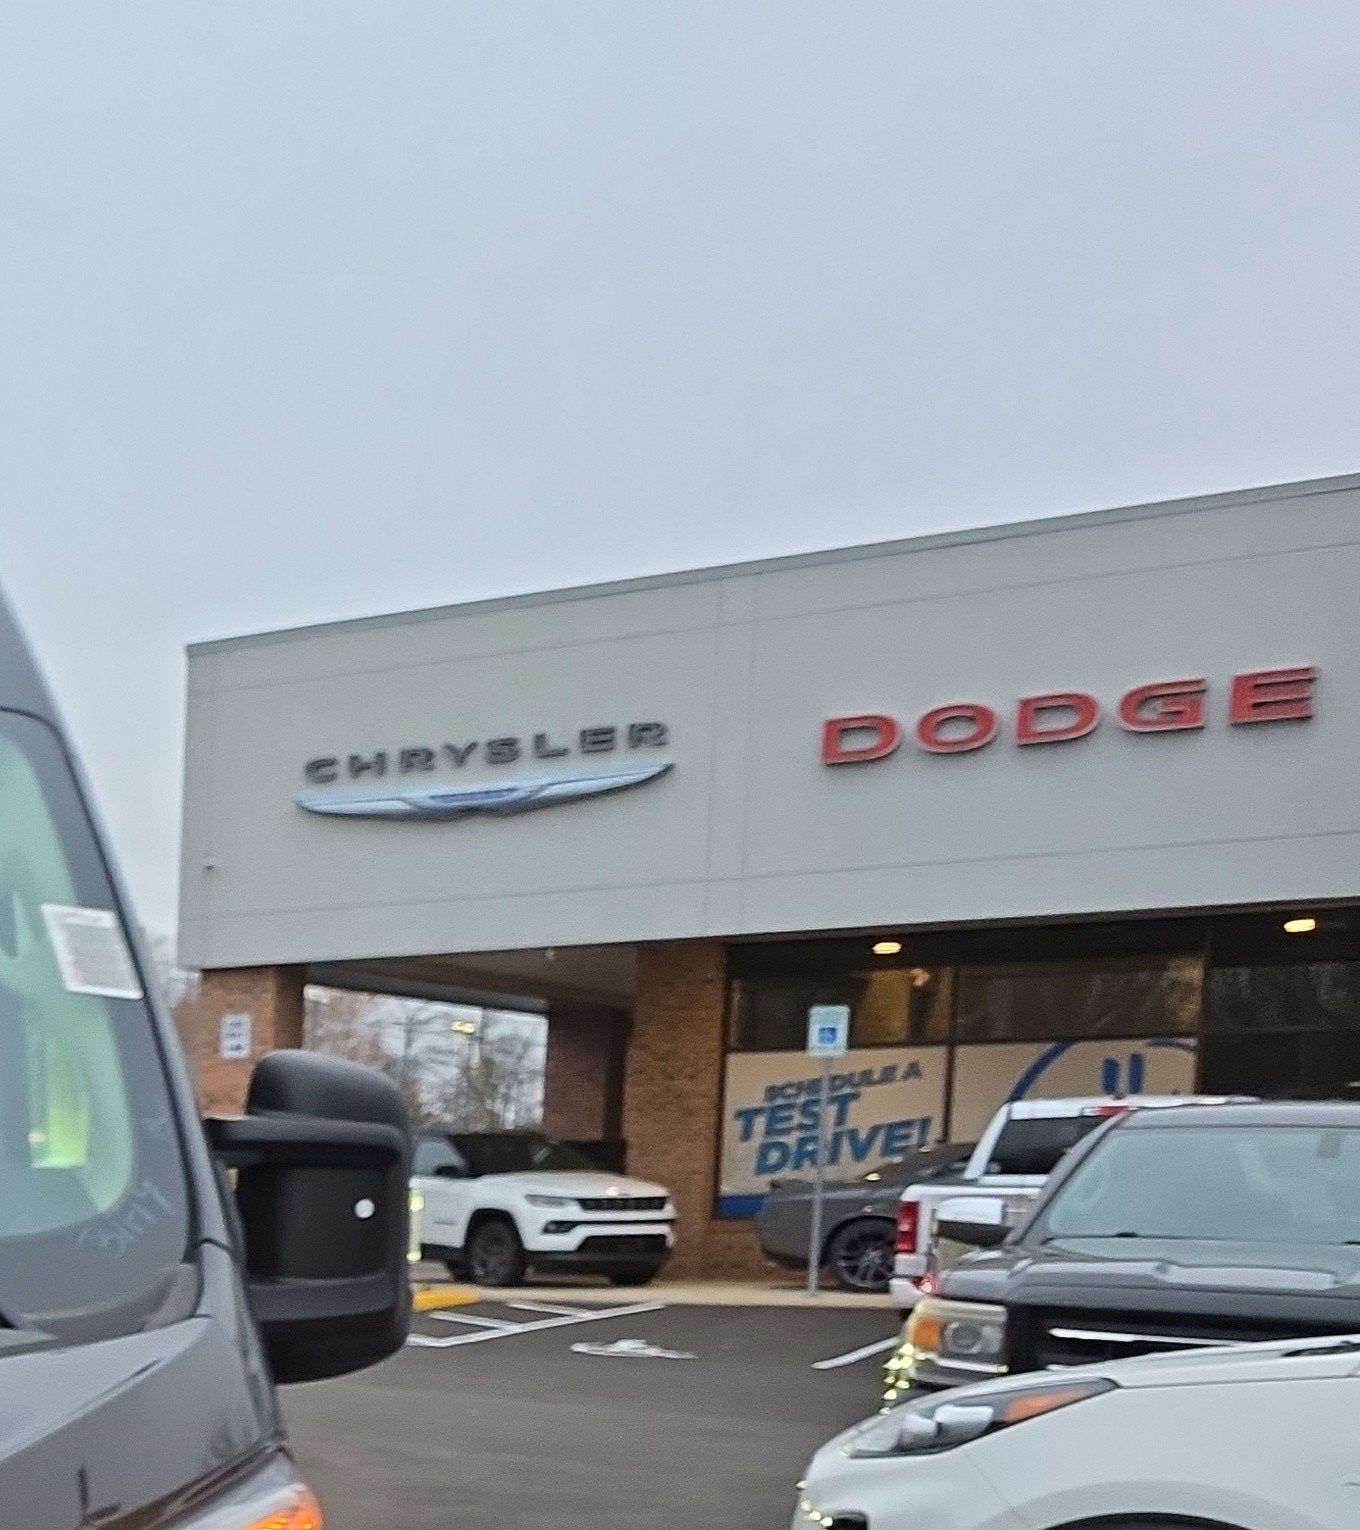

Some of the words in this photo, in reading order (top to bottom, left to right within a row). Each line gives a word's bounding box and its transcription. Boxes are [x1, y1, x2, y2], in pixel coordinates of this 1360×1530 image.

[821, 665, 1317, 765] DODGE
[304, 721, 670, 785] CHRYSLER
[734, 1091, 861, 1143] TEST
